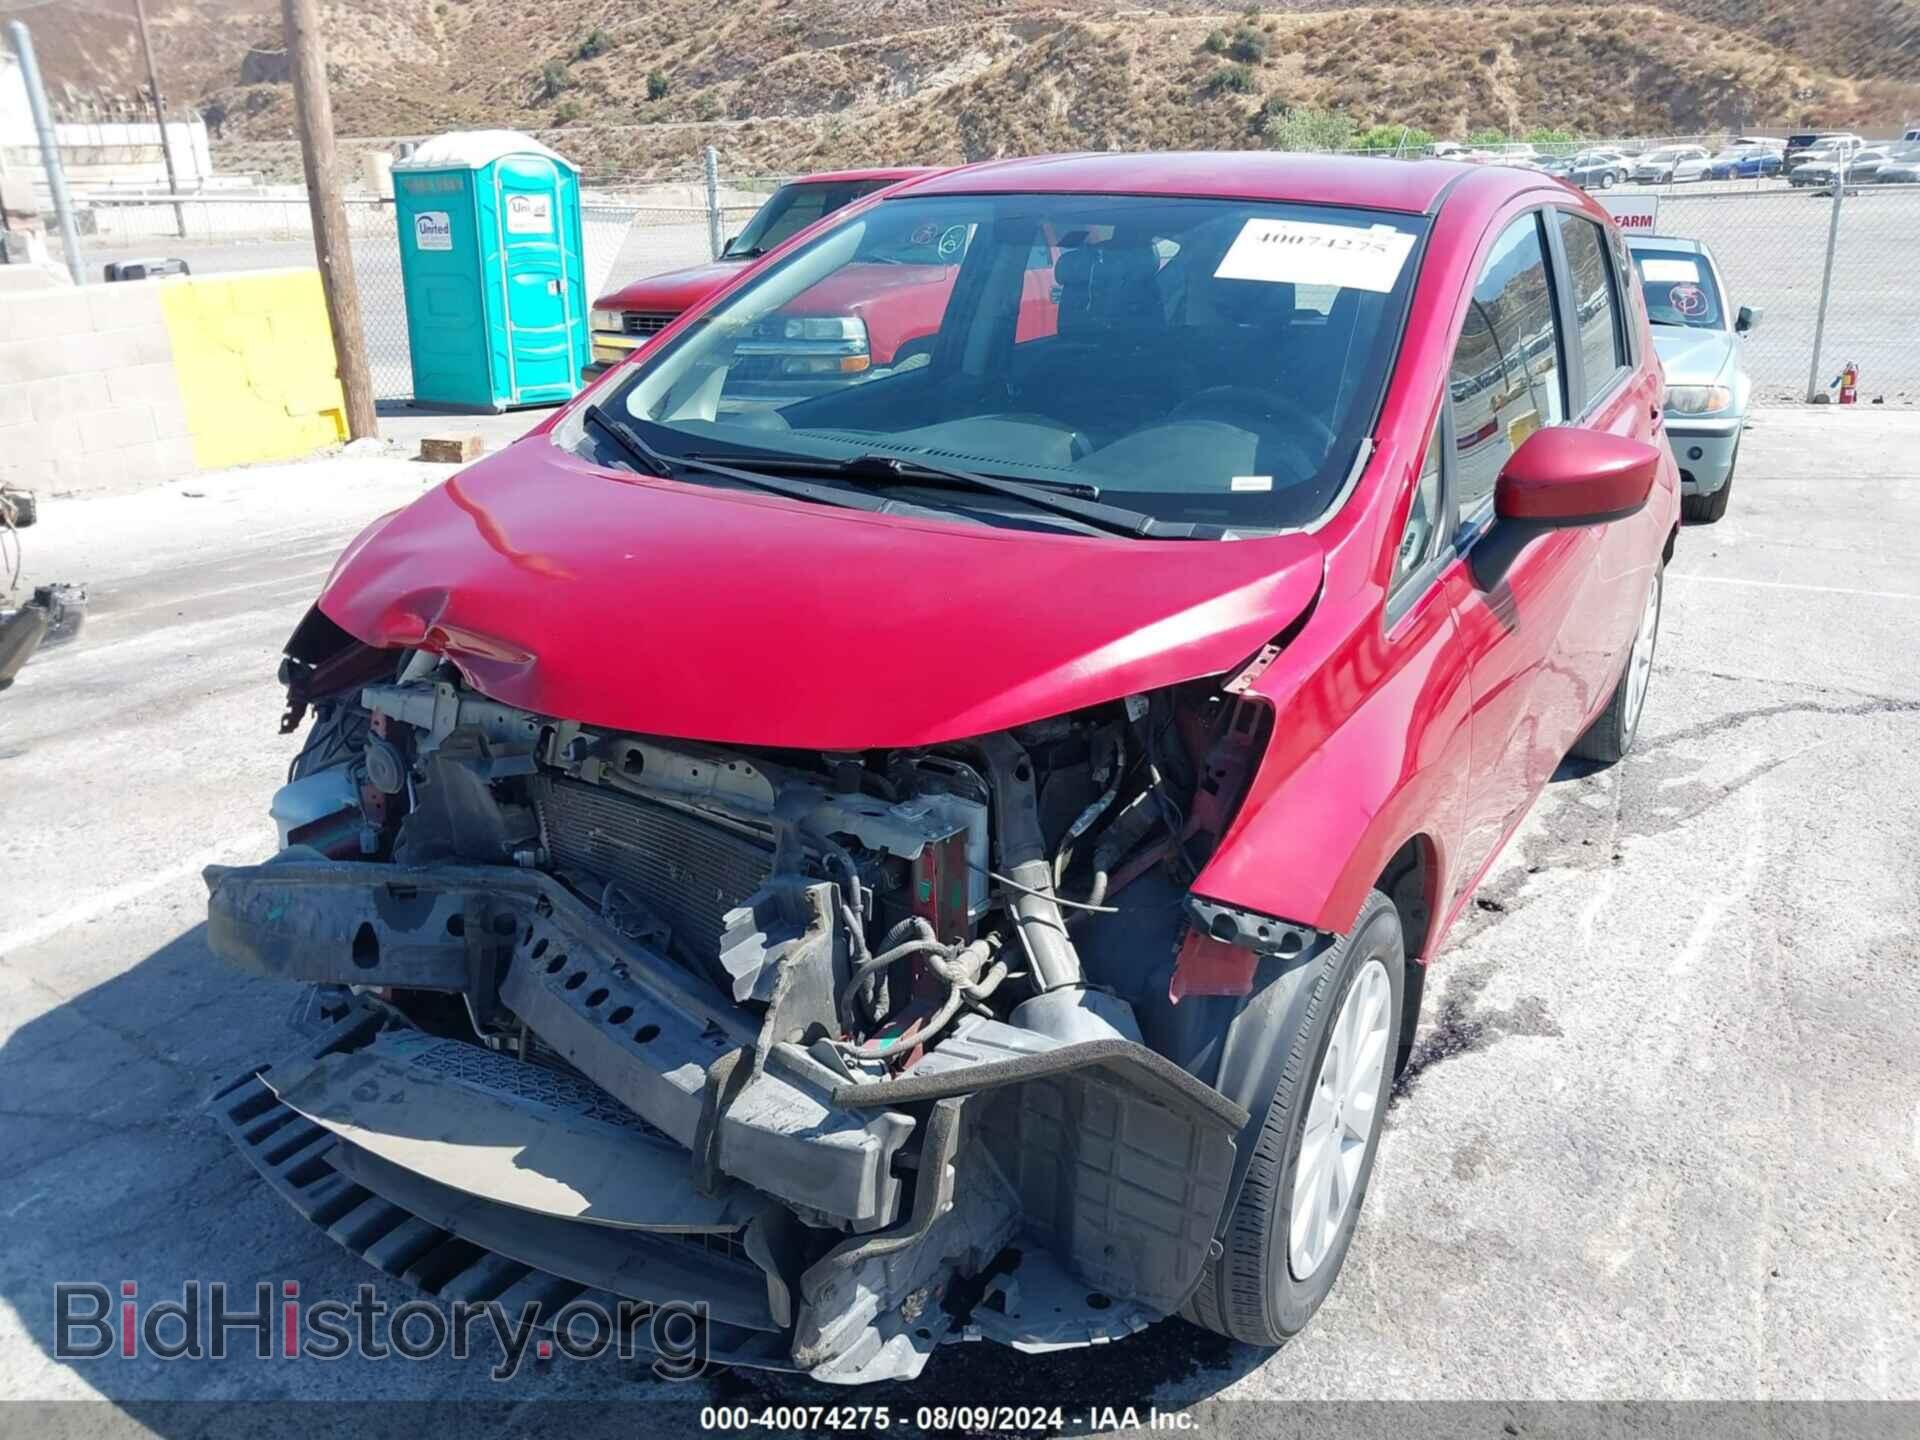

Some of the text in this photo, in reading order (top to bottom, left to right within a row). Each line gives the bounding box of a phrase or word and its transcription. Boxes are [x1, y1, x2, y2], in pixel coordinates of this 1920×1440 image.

[512, 201, 546, 214] Unied
[419, 221, 449, 235] United
[1614, 215, 1653, 228] FARM
[1256, 232, 1388, 253] 40074275
